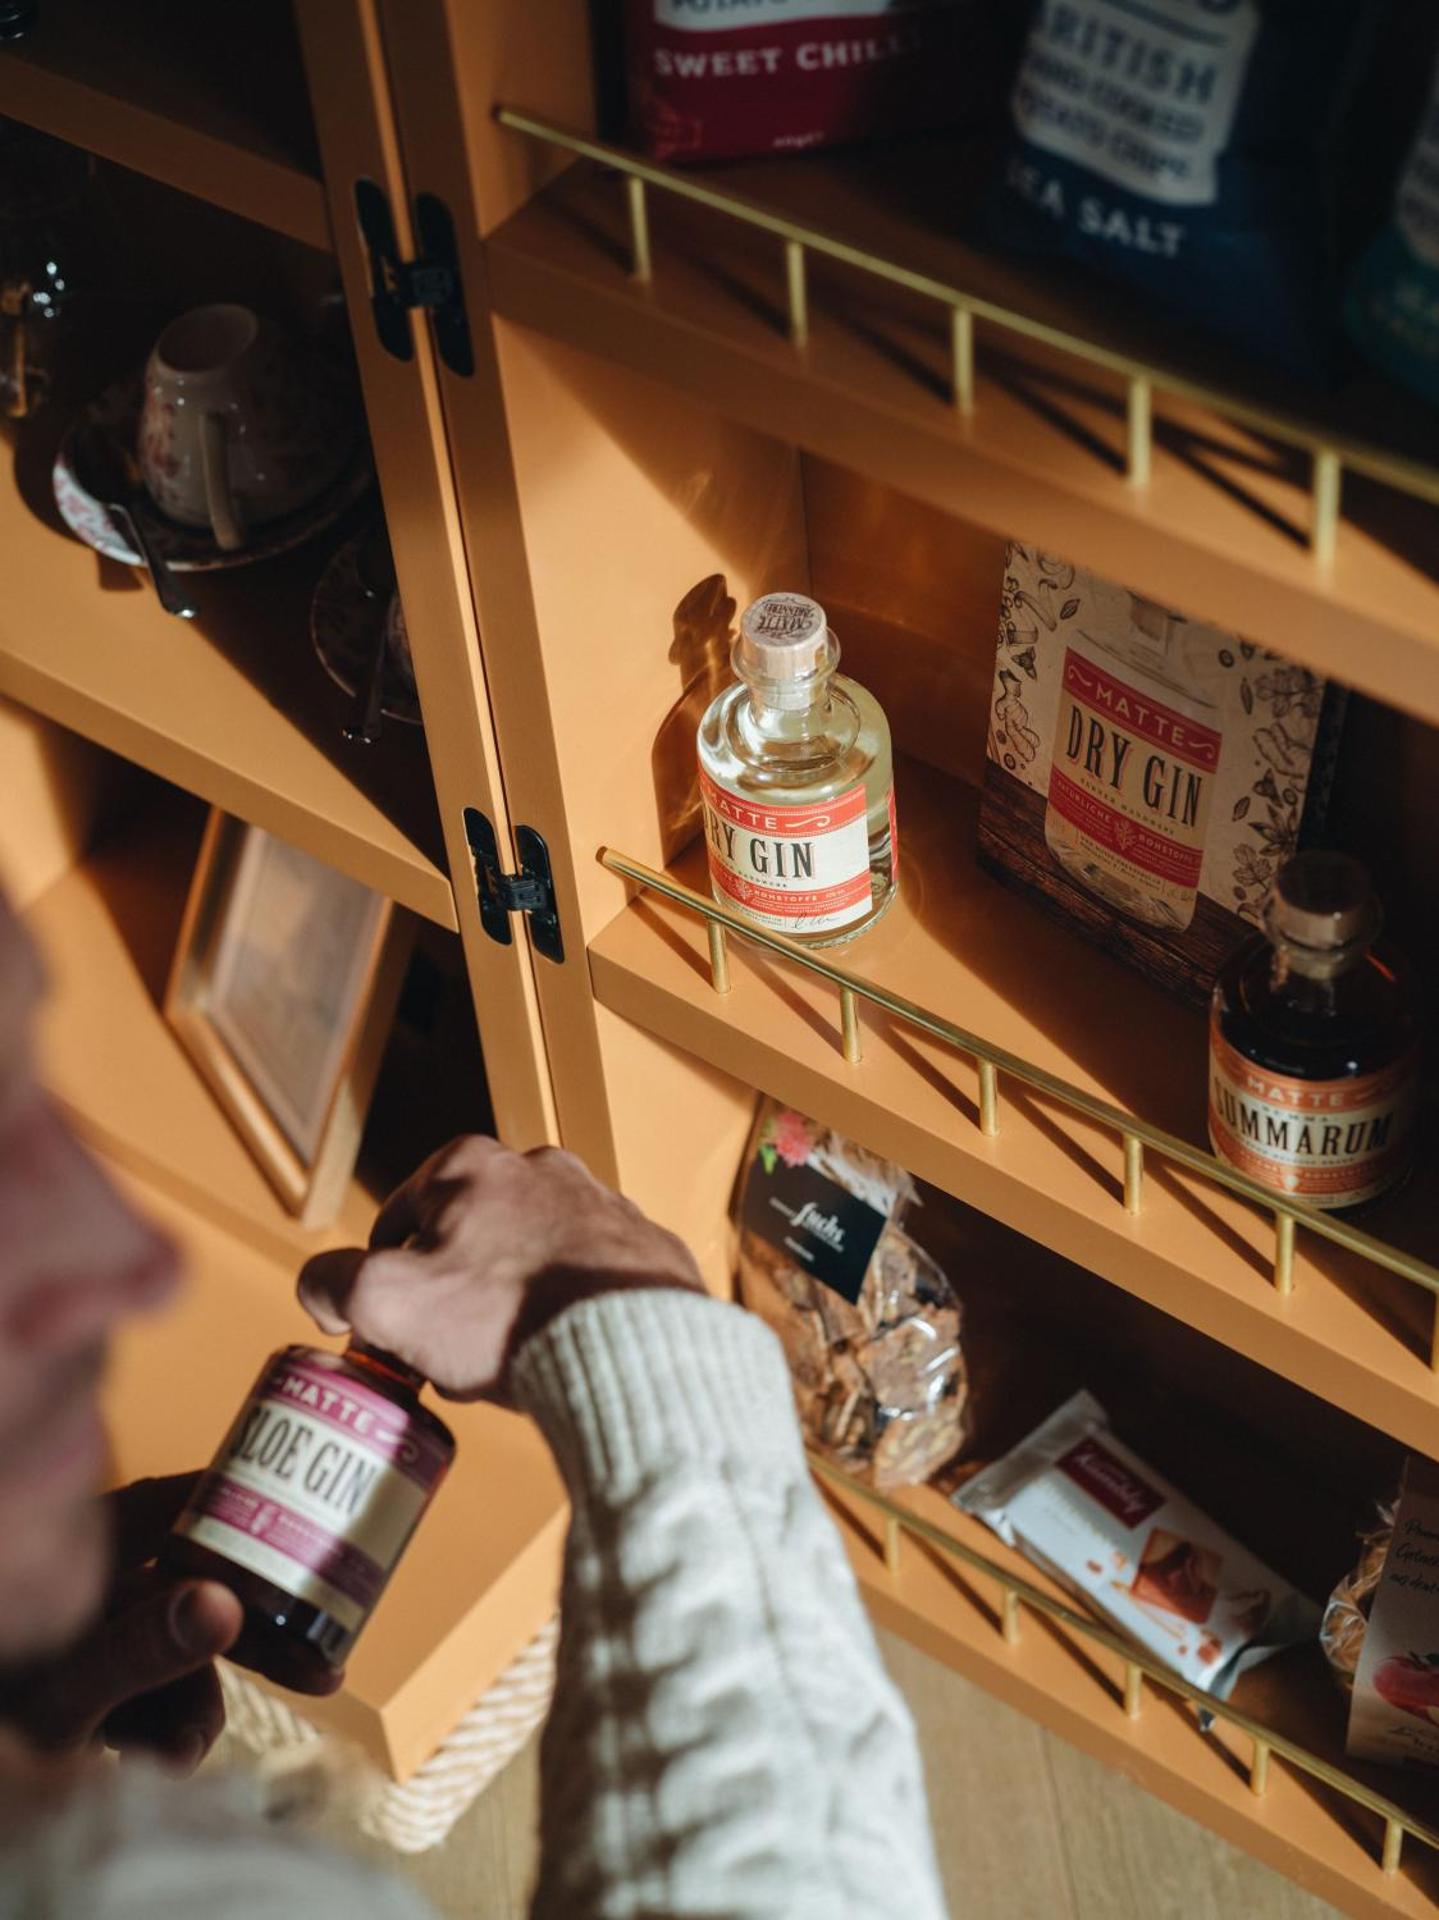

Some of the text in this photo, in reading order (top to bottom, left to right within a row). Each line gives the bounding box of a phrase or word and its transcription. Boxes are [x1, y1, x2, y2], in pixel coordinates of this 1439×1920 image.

[655, 47, 782, 78] SWEET
[1046, 6, 1218, 98] RITISH
[1077, 196, 1186, 259] SALT
[1095, 686, 1186, 748] MATTE
[1066, 705, 1203, 828] DRY GIN
[704, 806, 736, 861] RY
[750, 838, 814, 881] GIN
[1247, 1075, 1344, 1108] MATTE
[283, 1377, 371, 1433] MATTE
[304, 1441, 376, 1515] GIN
